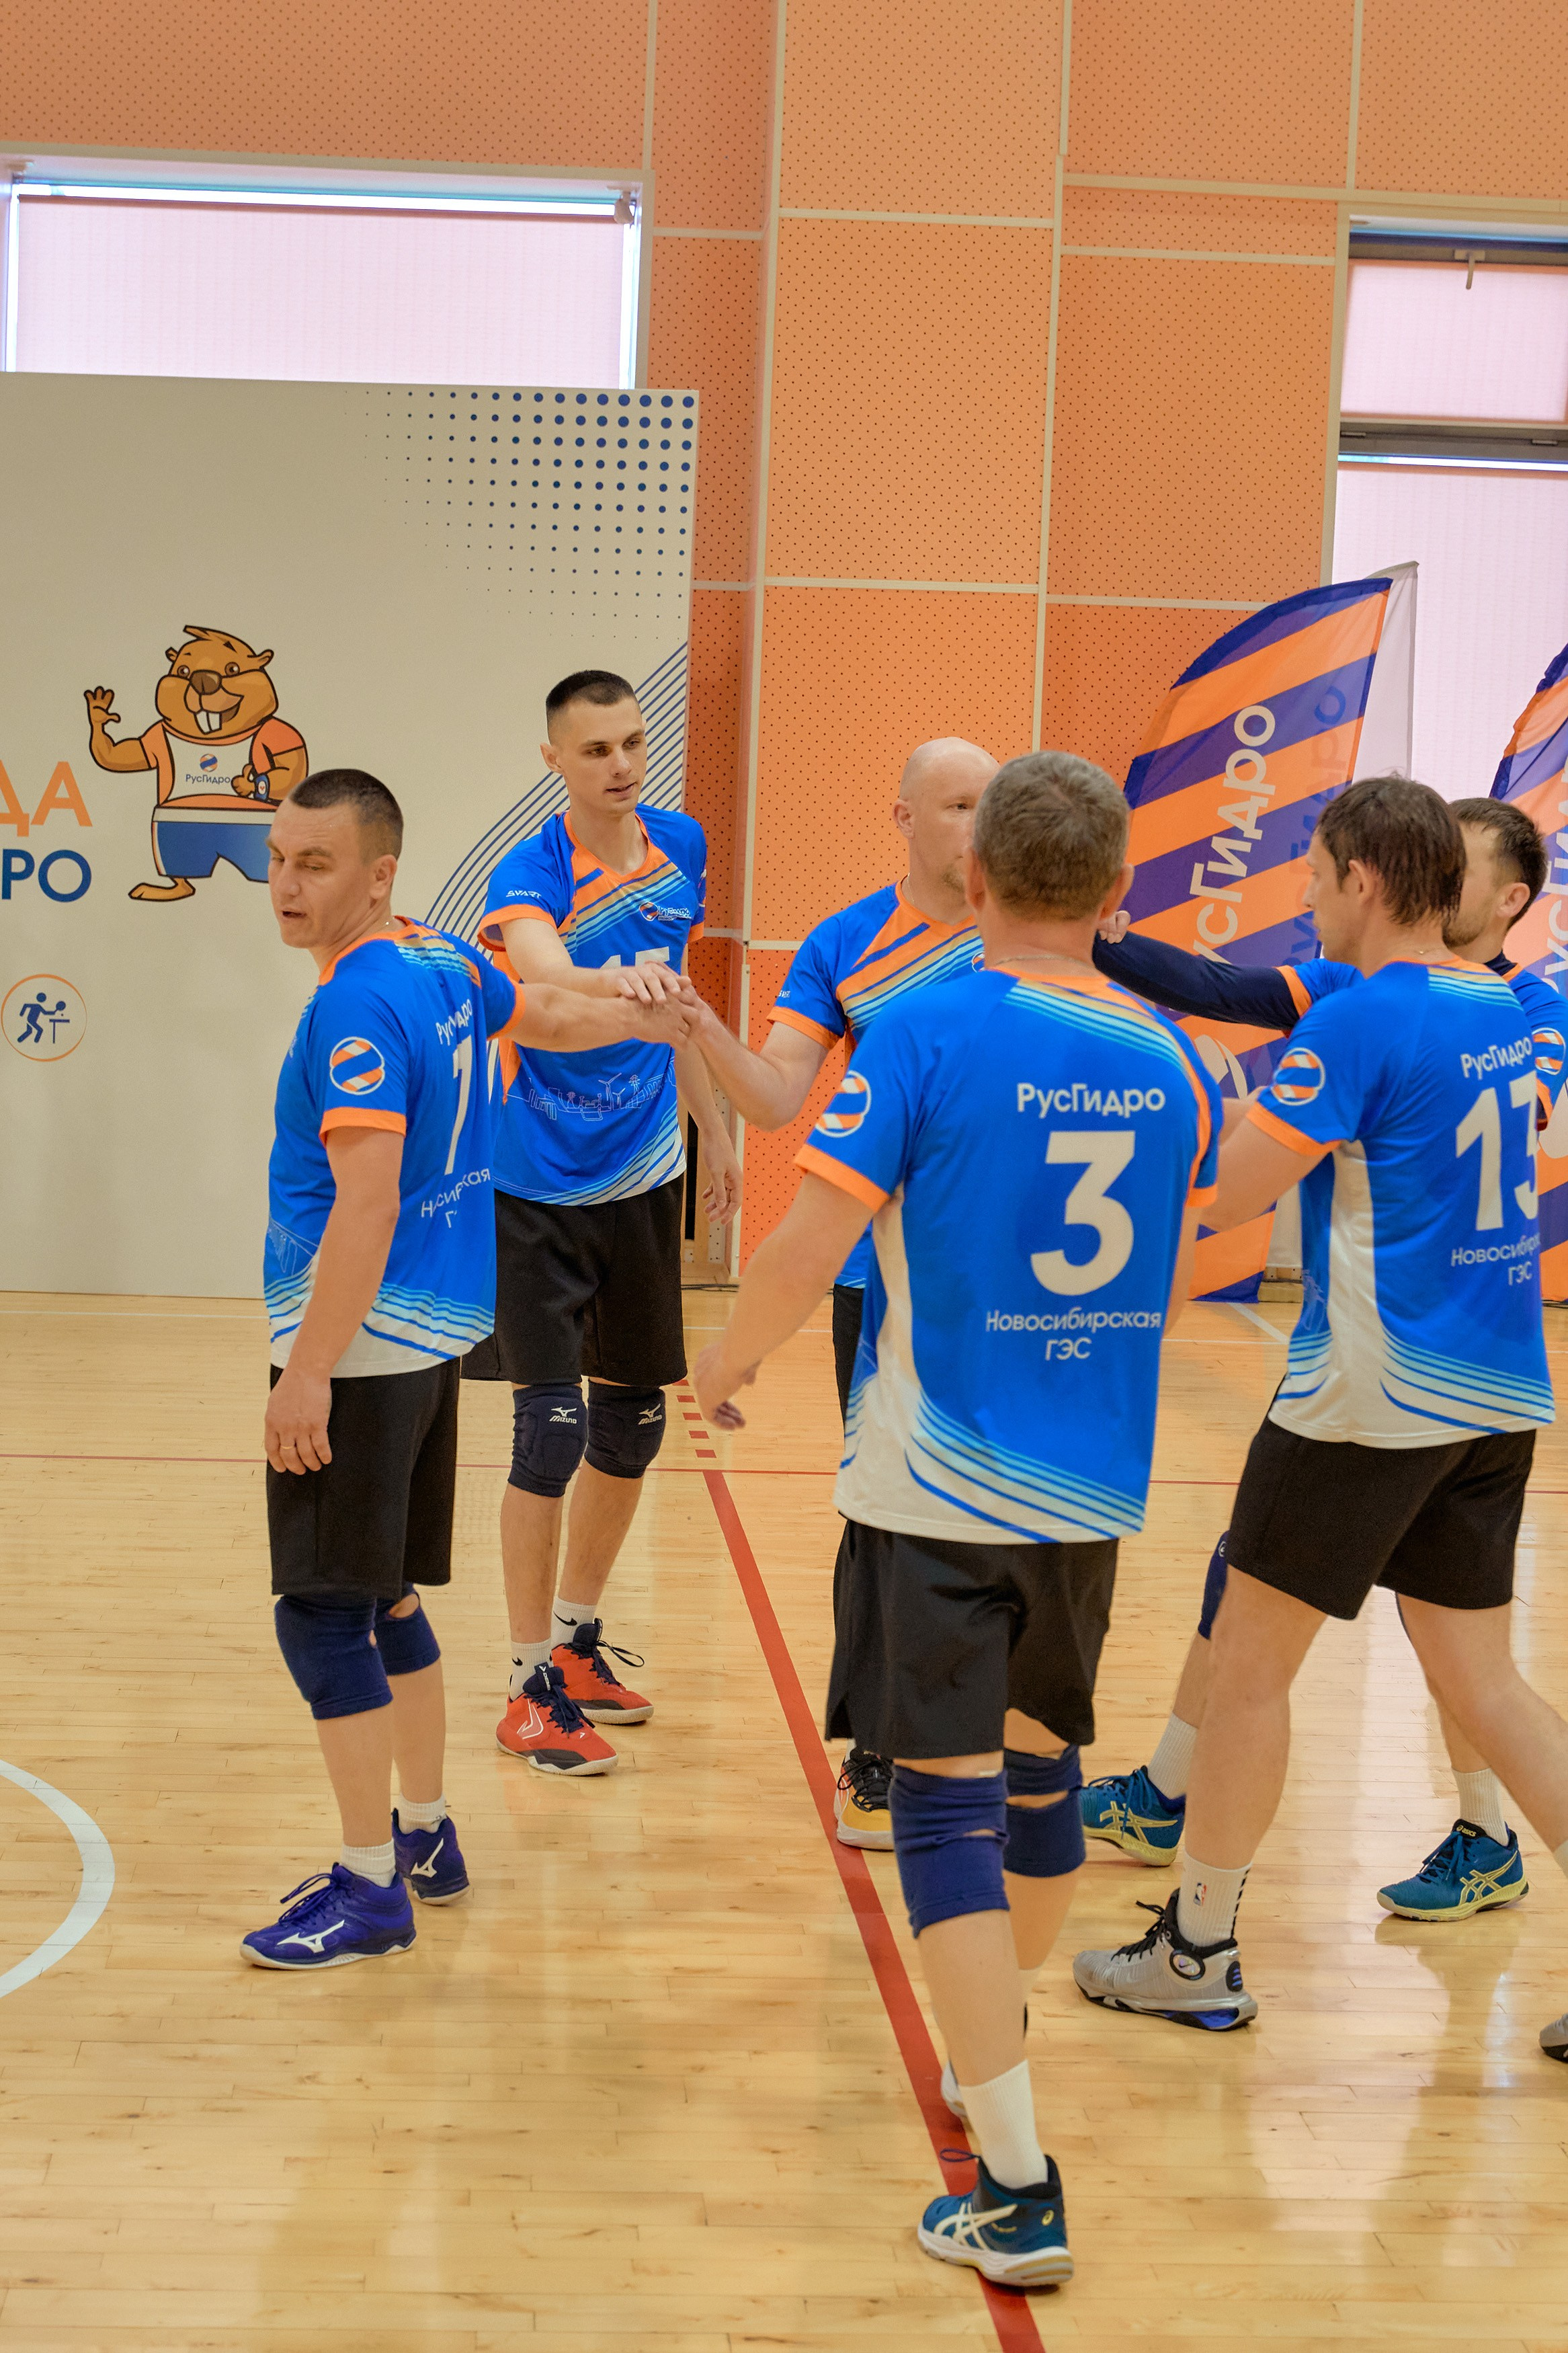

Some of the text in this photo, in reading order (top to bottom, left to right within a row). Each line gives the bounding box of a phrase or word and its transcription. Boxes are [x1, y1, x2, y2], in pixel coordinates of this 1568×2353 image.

[185, 774, 231, 785] РусГидро
[2, 848, 91, 903] РО
[505, 890, 542, 899] SVART
[1460, 1037, 1532, 1080] РусГидро
[1017, 1082, 1166, 1119] РусГидро
[1456, 1070, 1538, 1230] 13
[1030, 1131, 1135, 1295] 3
[986, 1307, 1162, 1333] Новосибирская
[1045, 1337, 1092, 1361] ГЭС
[549, 1415, 577, 1425] MIZUNO
[638, 1414, 663, 1425] MIZUNO
